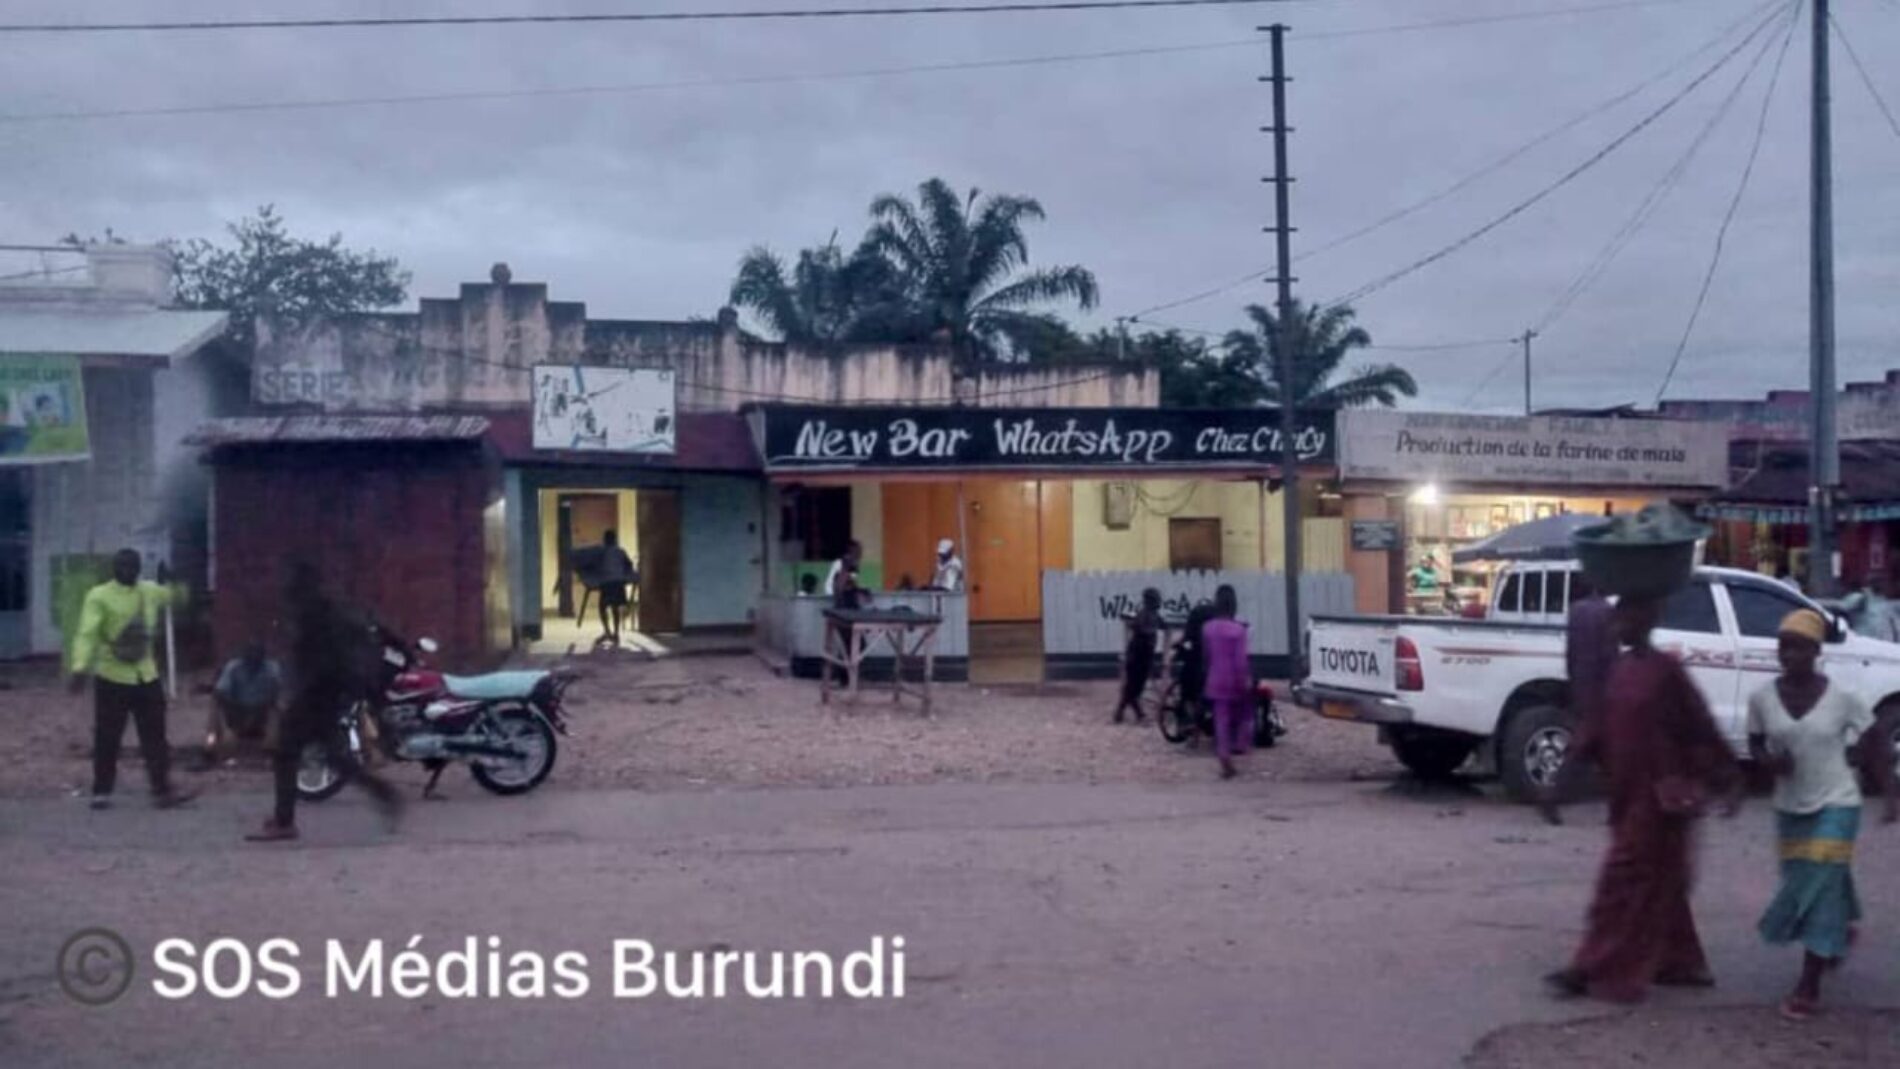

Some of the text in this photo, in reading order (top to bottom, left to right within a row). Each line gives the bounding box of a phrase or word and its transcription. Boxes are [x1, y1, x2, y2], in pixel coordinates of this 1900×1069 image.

[795, 420, 878, 457] New
[889, 419, 971, 457] Bar
[994, 418, 1174, 463] WhatsApp
[1196, 426, 1249, 452] Chez
[1396, 429, 1504, 456] Production
[1507, 440, 1528, 457] de
[1533, 440, 1552, 458] la
[1556, 440, 1614, 461] farine
[1616, 445, 1639, 462] de
[1319, 647, 1380, 677] TOYOTA
